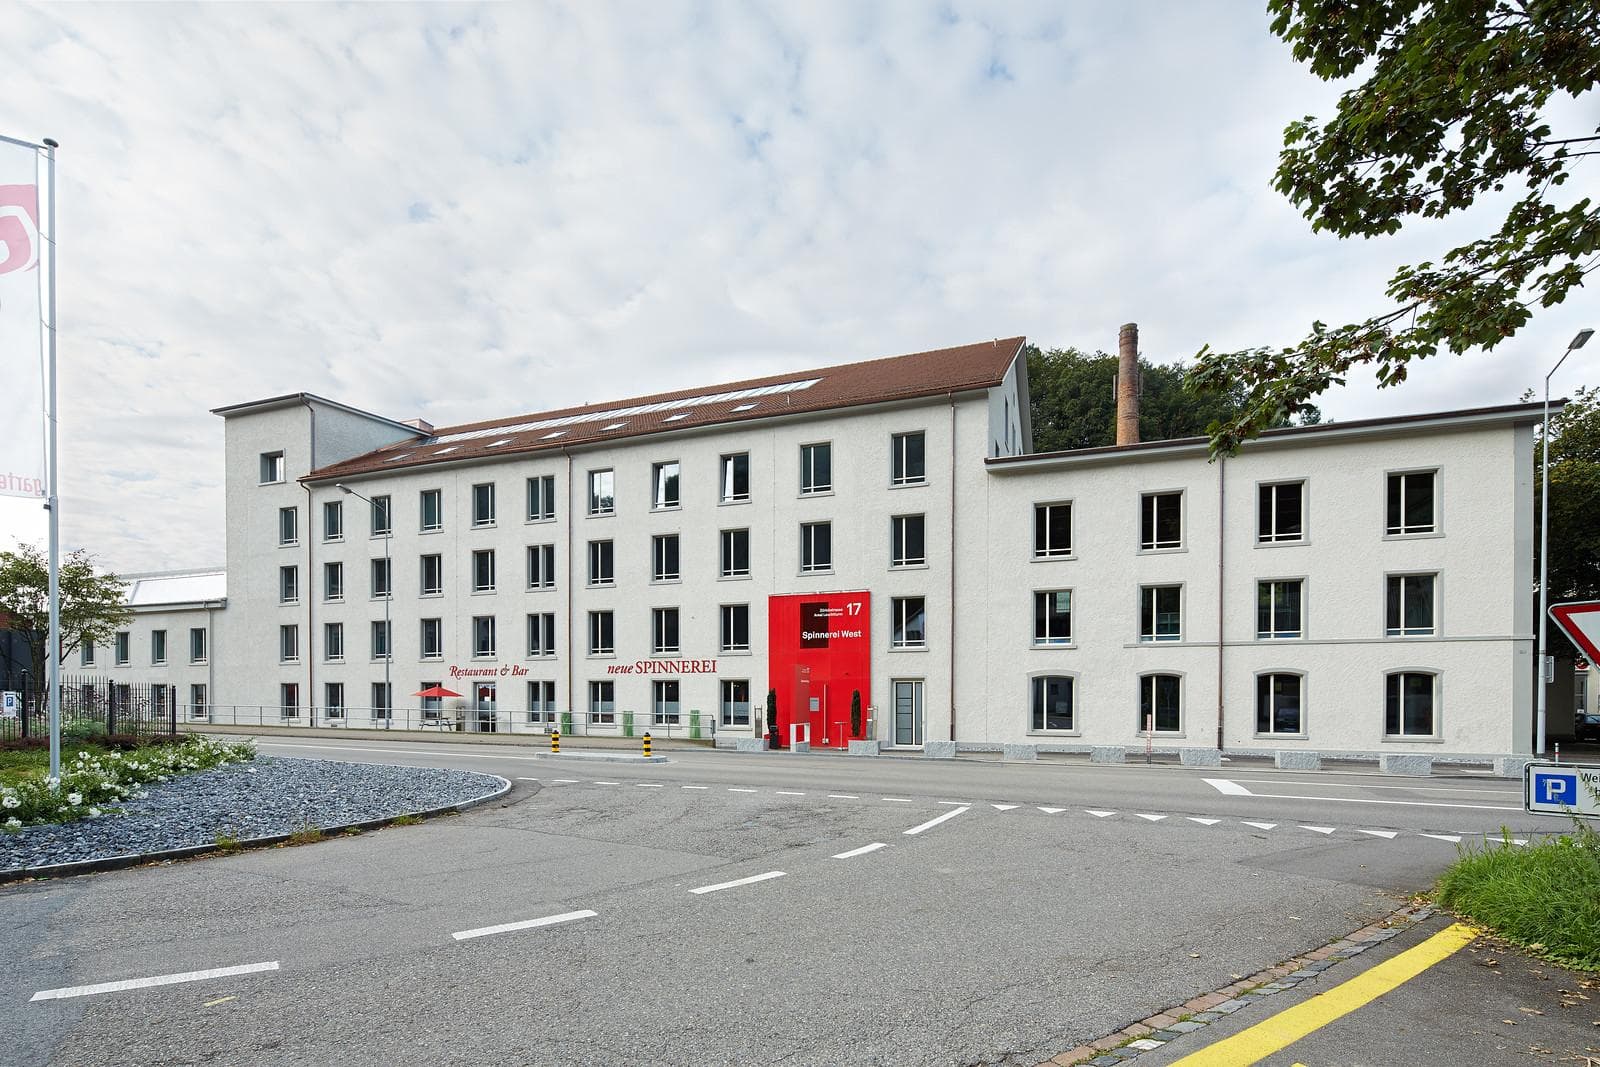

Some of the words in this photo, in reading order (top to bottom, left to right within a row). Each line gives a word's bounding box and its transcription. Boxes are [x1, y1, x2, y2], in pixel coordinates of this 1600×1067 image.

[846, 602, 862, 616] 17
[802, 631, 840, 640] Spinnerei
[841, 630, 862, 638] West
[449, 665, 498, 680] Restaurant
[500, 664, 510, 676] &
[512, 665, 529, 676] Bar
[607, 665, 634, 674] neue
[635, 660, 718, 674] SPINNEREI
[1546, 779, 1566, 800] P
